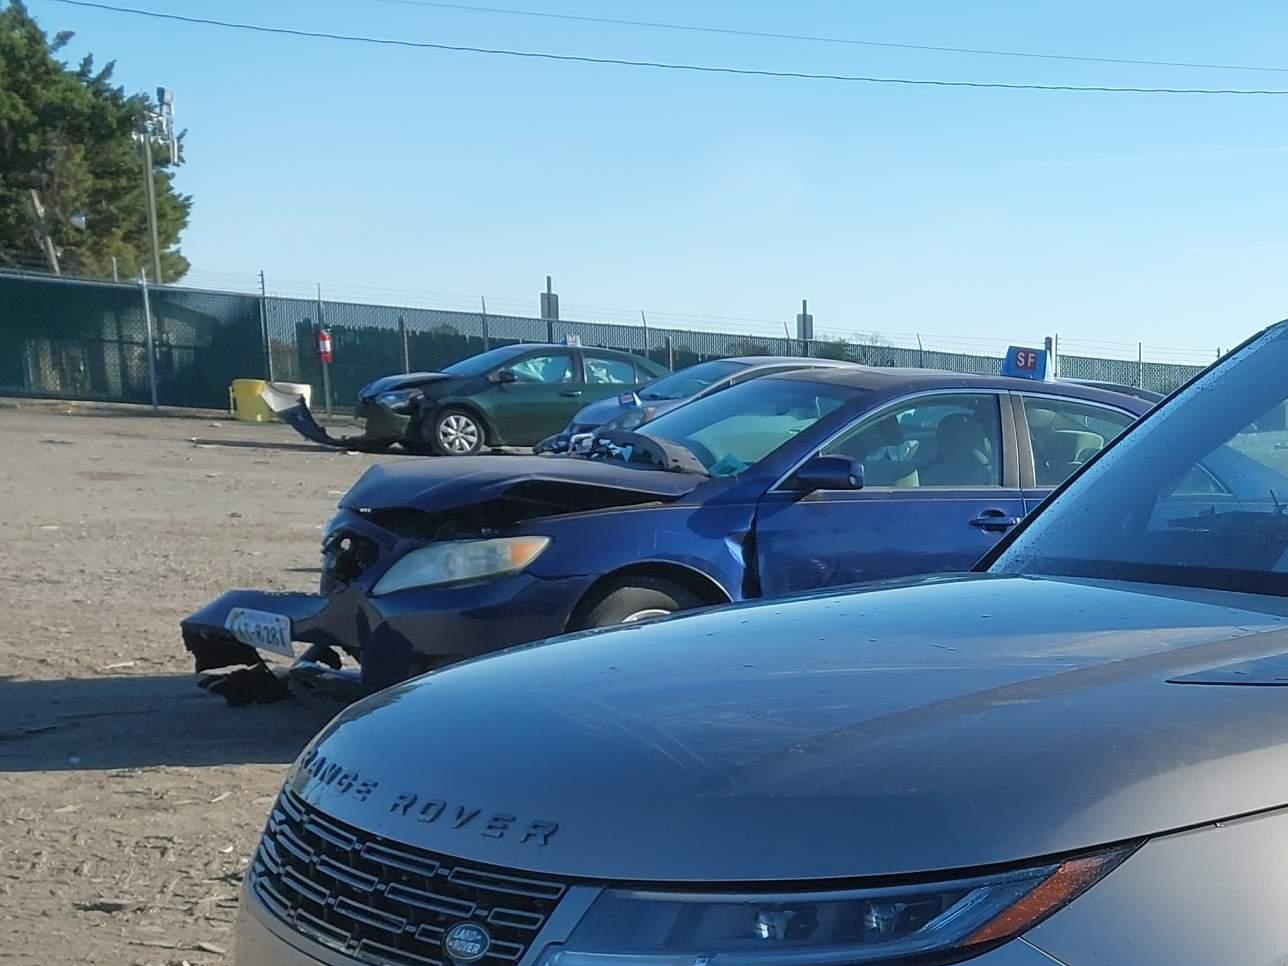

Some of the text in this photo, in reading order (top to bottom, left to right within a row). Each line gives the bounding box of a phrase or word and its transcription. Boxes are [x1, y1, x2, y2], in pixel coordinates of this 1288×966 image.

[1017, 352, 1036, 367] SF
[301, 750, 559, 847] RANGE ROVER
